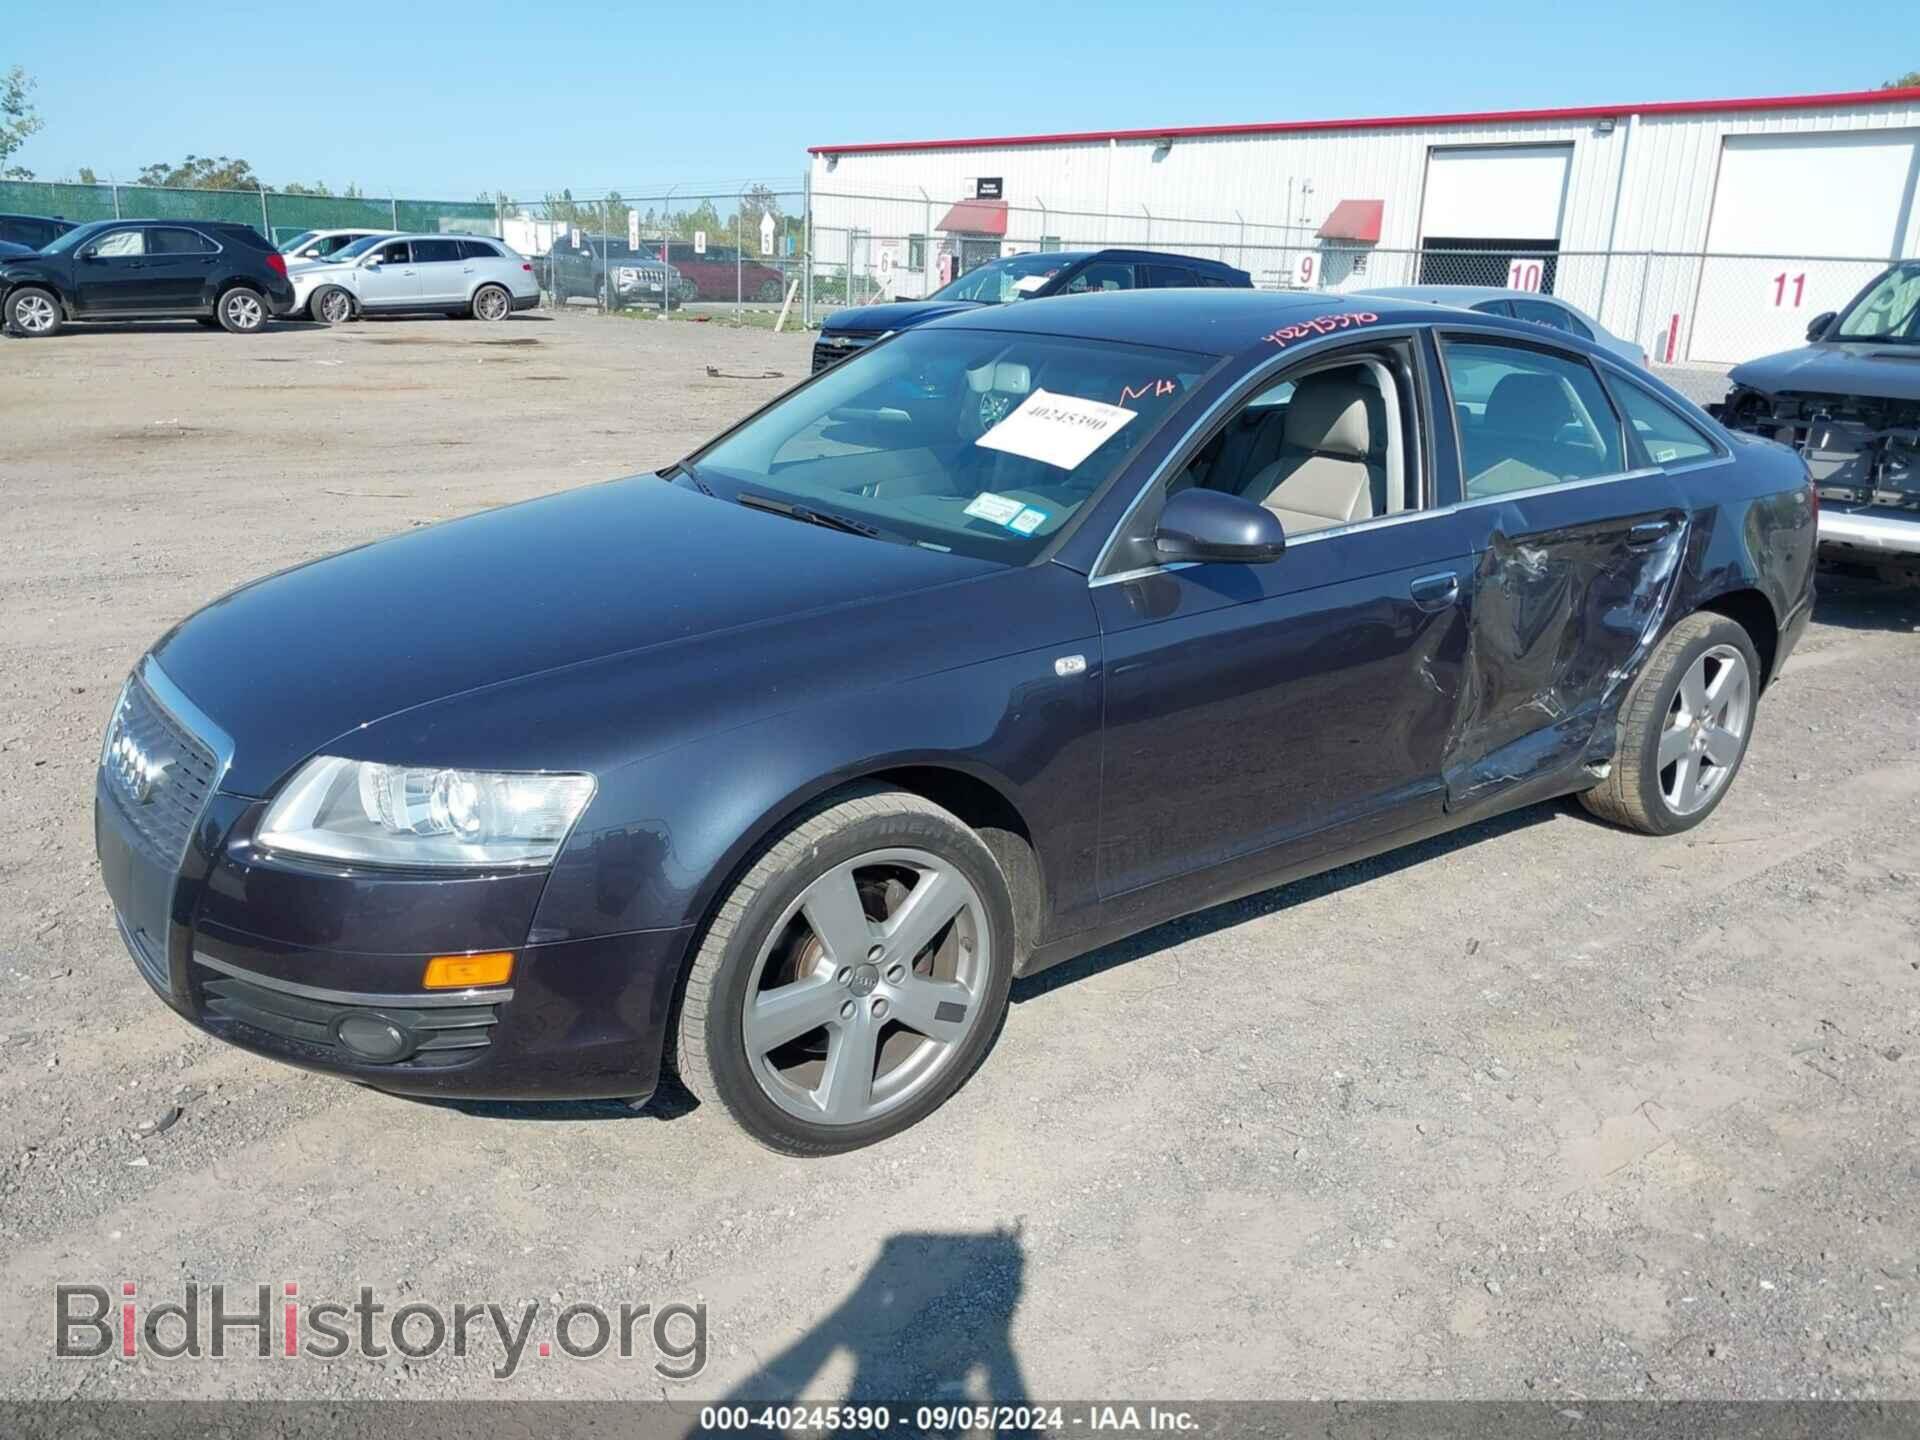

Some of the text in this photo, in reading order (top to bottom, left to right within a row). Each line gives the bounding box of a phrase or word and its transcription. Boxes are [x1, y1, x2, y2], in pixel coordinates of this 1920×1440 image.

[881, 251, 889, 272] 6
[1300, 256, 1314, 284] 9
[1511, 264, 1541, 293] 10
[1773, 272, 1806, 308] 11
[1026, 404, 1110, 432] 40245390
